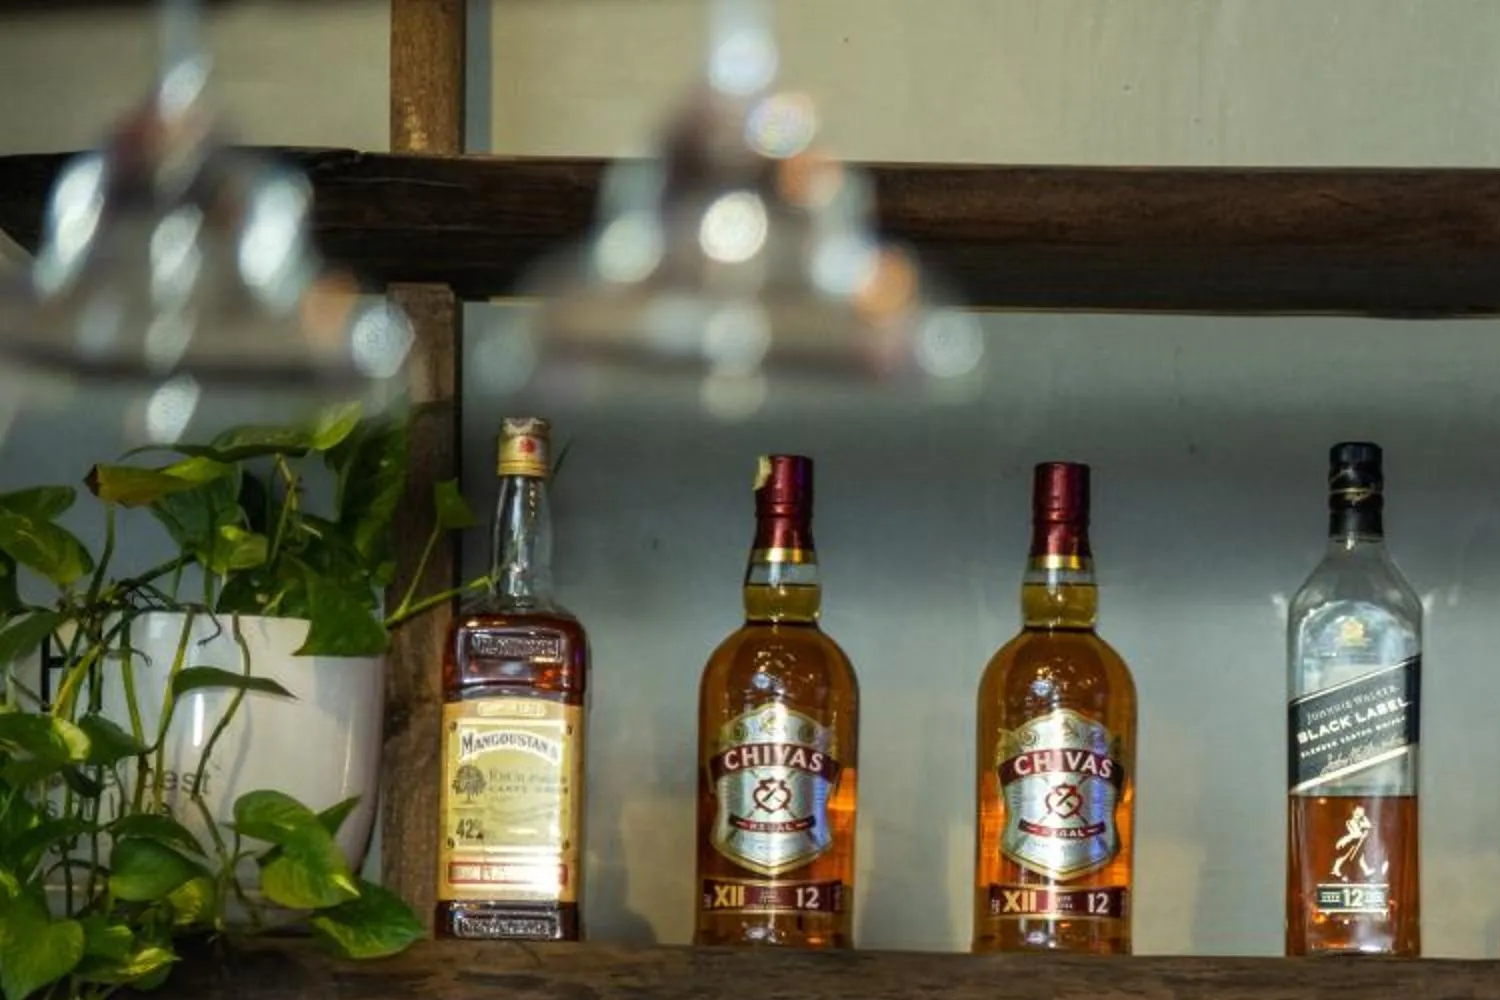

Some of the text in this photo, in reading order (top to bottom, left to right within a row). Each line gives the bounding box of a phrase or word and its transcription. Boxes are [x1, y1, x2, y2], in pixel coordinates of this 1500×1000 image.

[1297, 697, 1410, 743] BLACK LABEL
[723, 742, 825, 772] CHIVAS
[714, 885, 746, 908] XII
[795, 887, 821, 909] 12
[1003, 890, 1036, 913] XII
[1088, 893, 1110, 914] 12
[1343, 887, 1364, 907] 12
